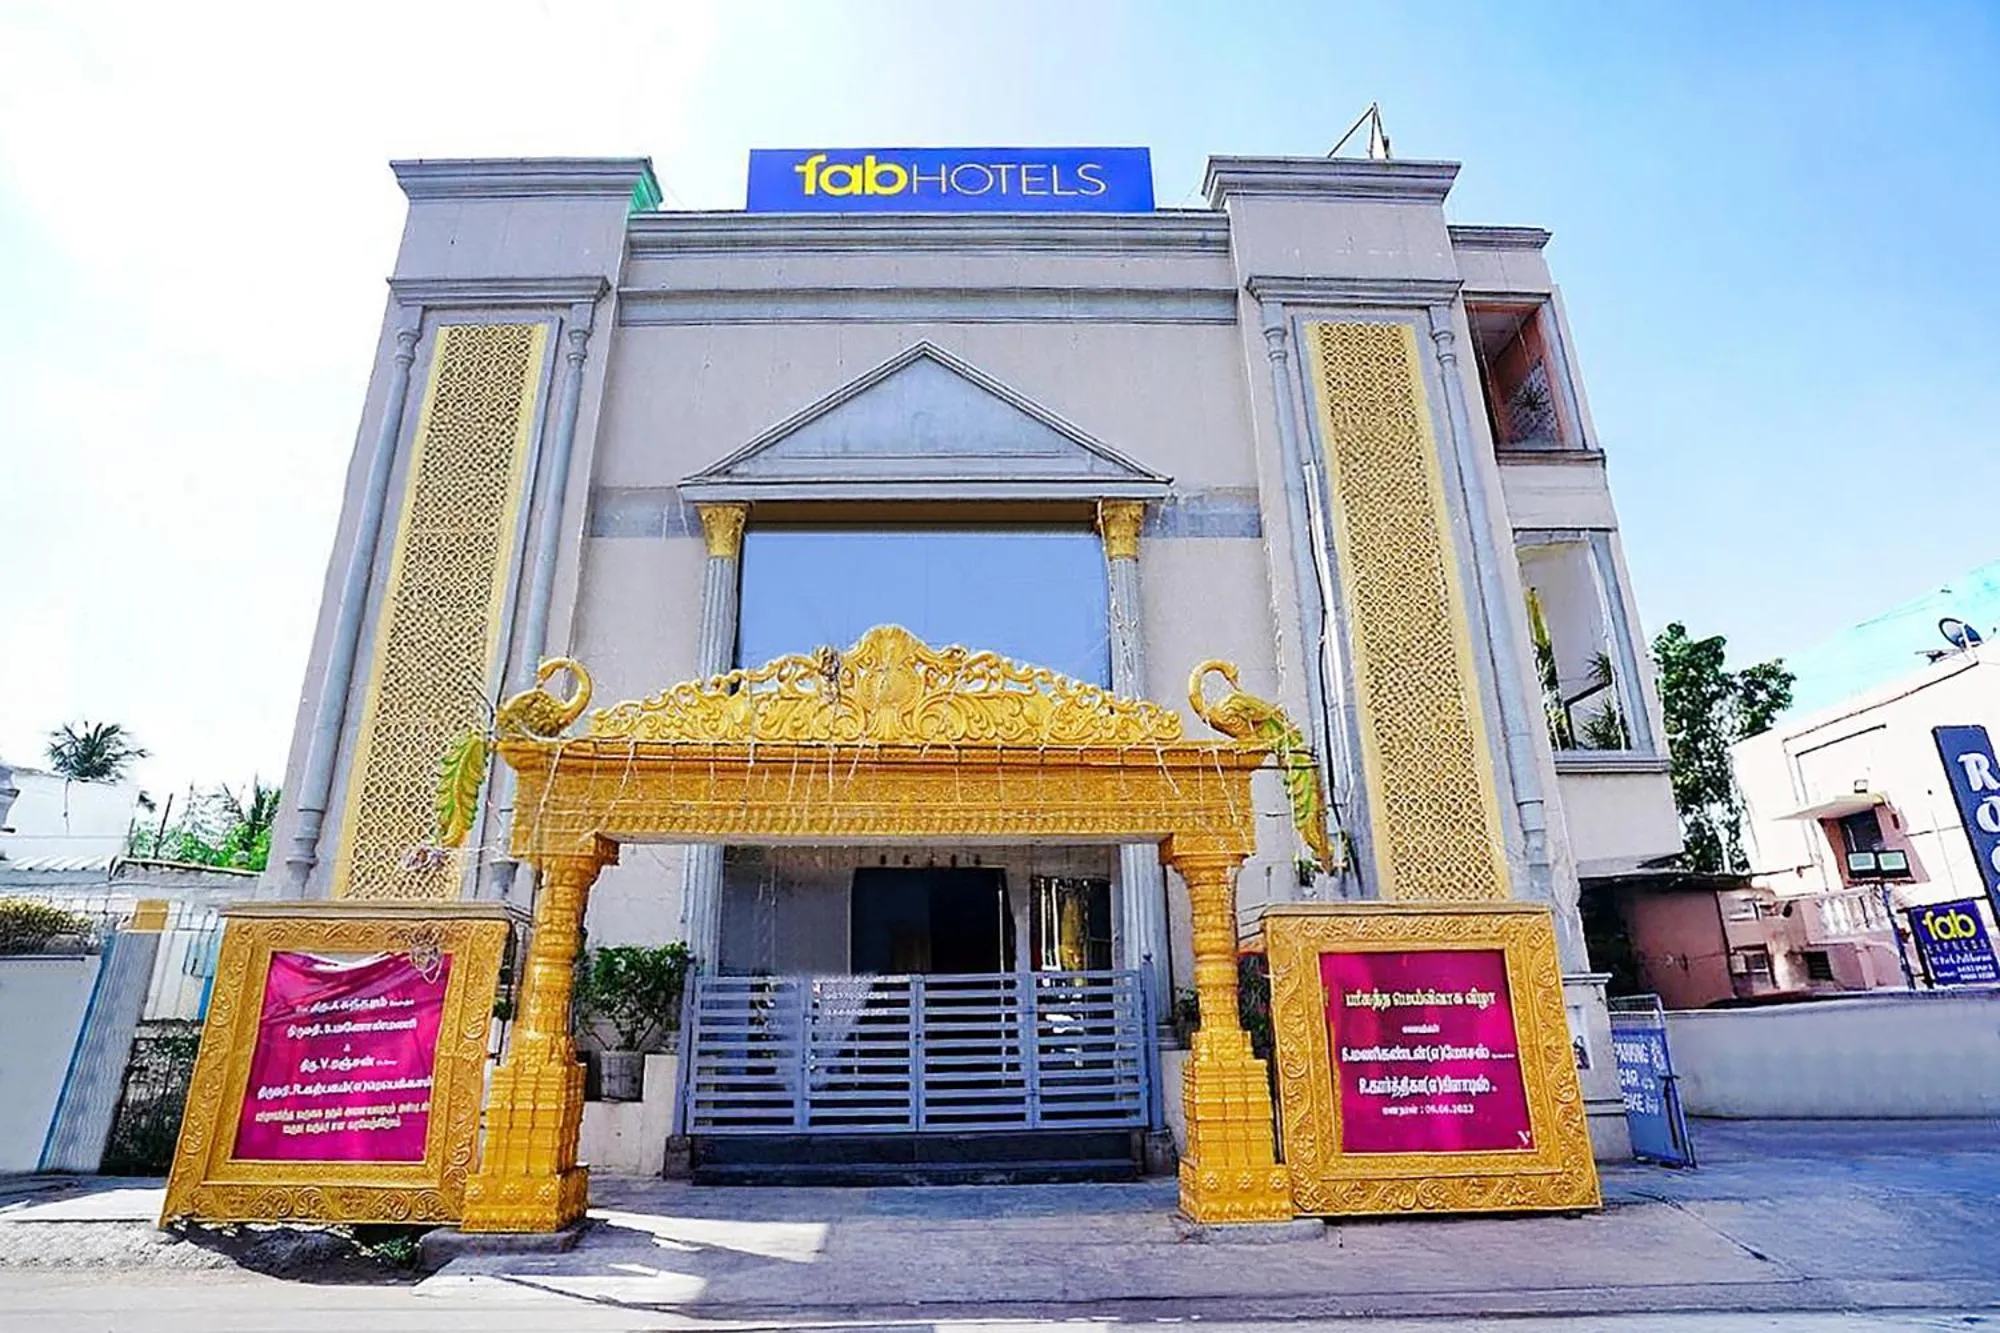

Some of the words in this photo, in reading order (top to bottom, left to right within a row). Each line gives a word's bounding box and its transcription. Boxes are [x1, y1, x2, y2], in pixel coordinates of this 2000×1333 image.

[794, 153, 1107, 196] fabHOTELS
[1921, 908, 1976, 940] fab
[1465, 987, 1496, 1010] விழா
